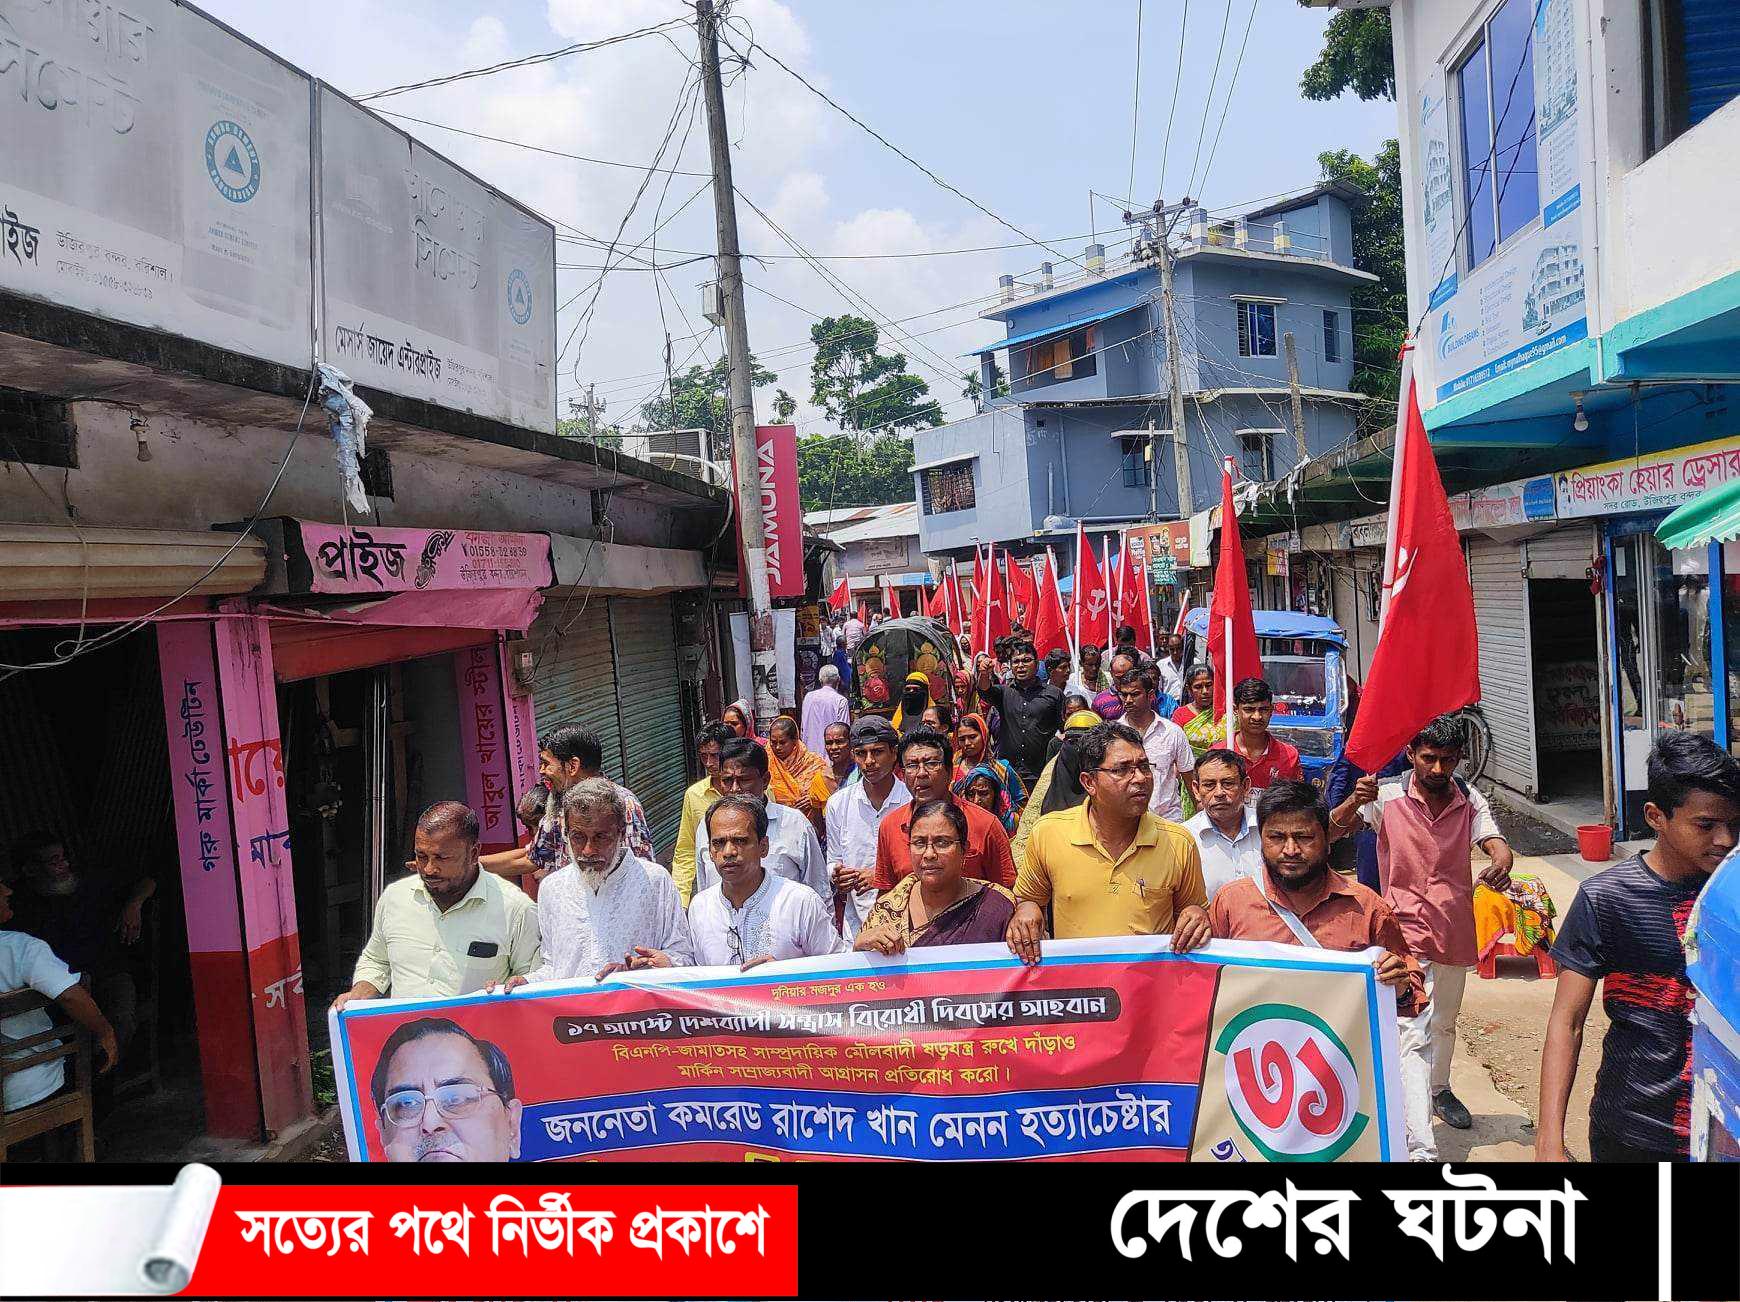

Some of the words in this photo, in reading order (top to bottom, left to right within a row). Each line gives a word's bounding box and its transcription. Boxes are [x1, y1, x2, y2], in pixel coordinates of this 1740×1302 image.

[1629, 462, 1674, 494] হেয়ার
[757, 438, 782, 586] JAMUNA
[846, 982, 865, 992] এক
[868, 981, 886, 991] হও
[567, 1023, 599, 1036] ১৭
[604, 1013, 674, 1036] আগস্ট
[679, 1009, 770, 1034] দেশব্যাপী
[849, 1000, 926, 1031] বিরোধী
[932, 998, 1013, 1025] দিবসের
[845, 1039, 916, 1060] মৌলবাদী
[923, 1040, 975, 1060] ষড়যন্ত্র
[980, 1037, 1018, 1056] রুখে
[1023, 1031, 1076, 1055] দাঁড়াও
[677, 1063, 724, 1078] মার্কিন
[818, 1066, 879, 1084] আগ্রাসন
[884, 1066, 953, 1085] প্রতিরোধ
[959, 1066, 999, 1084] করো
[541, 1101, 657, 1143] জননেতা
[663, 1101, 763, 1131] কমরেড
[768, 1101, 857, 1142] রাশেদ
[866, 1104, 918, 1148] খান
[929, 1109, 1010, 1148] মেনন
[1015, 1088, 1171, 1148] হত্যাচেষ্টার
